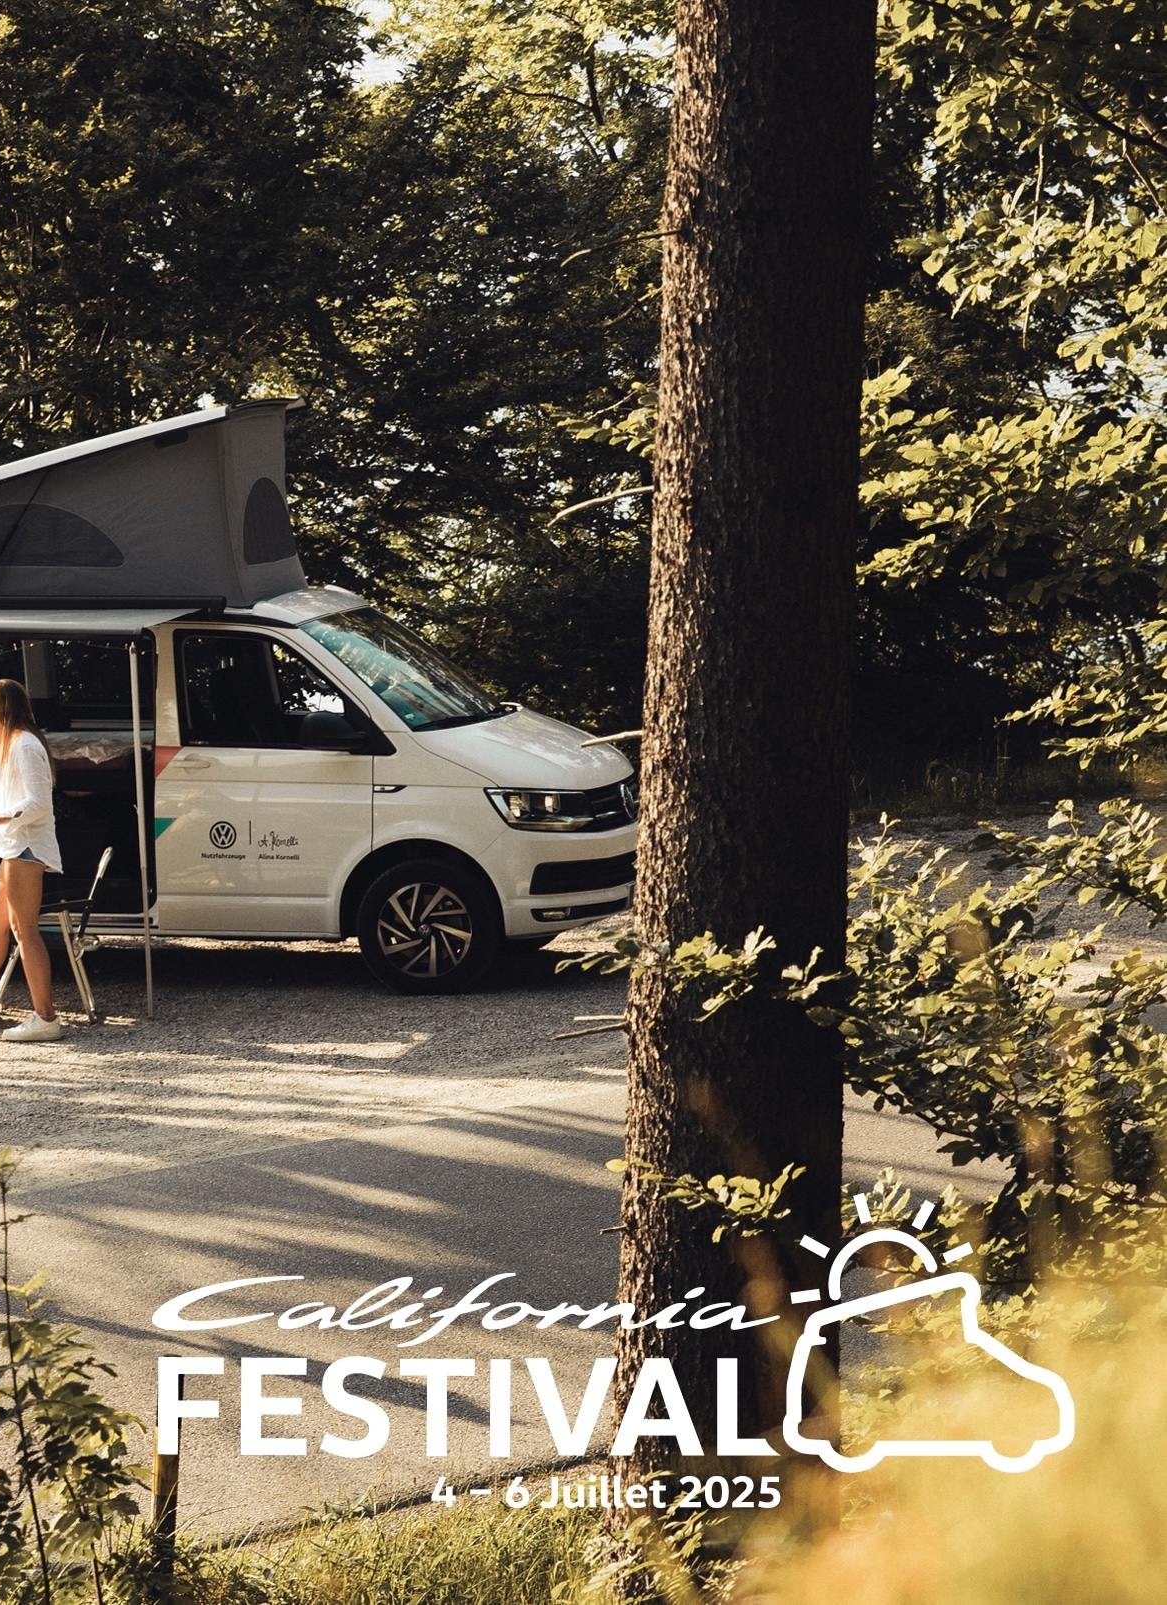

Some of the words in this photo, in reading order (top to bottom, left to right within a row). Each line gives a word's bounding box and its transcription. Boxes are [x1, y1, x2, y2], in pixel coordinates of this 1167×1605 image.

[201, 852, 246, 861] Nutzfahrzeuge
[258, 853, 275, 861] Alina
[276, 853, 301, 861] Kornelli
